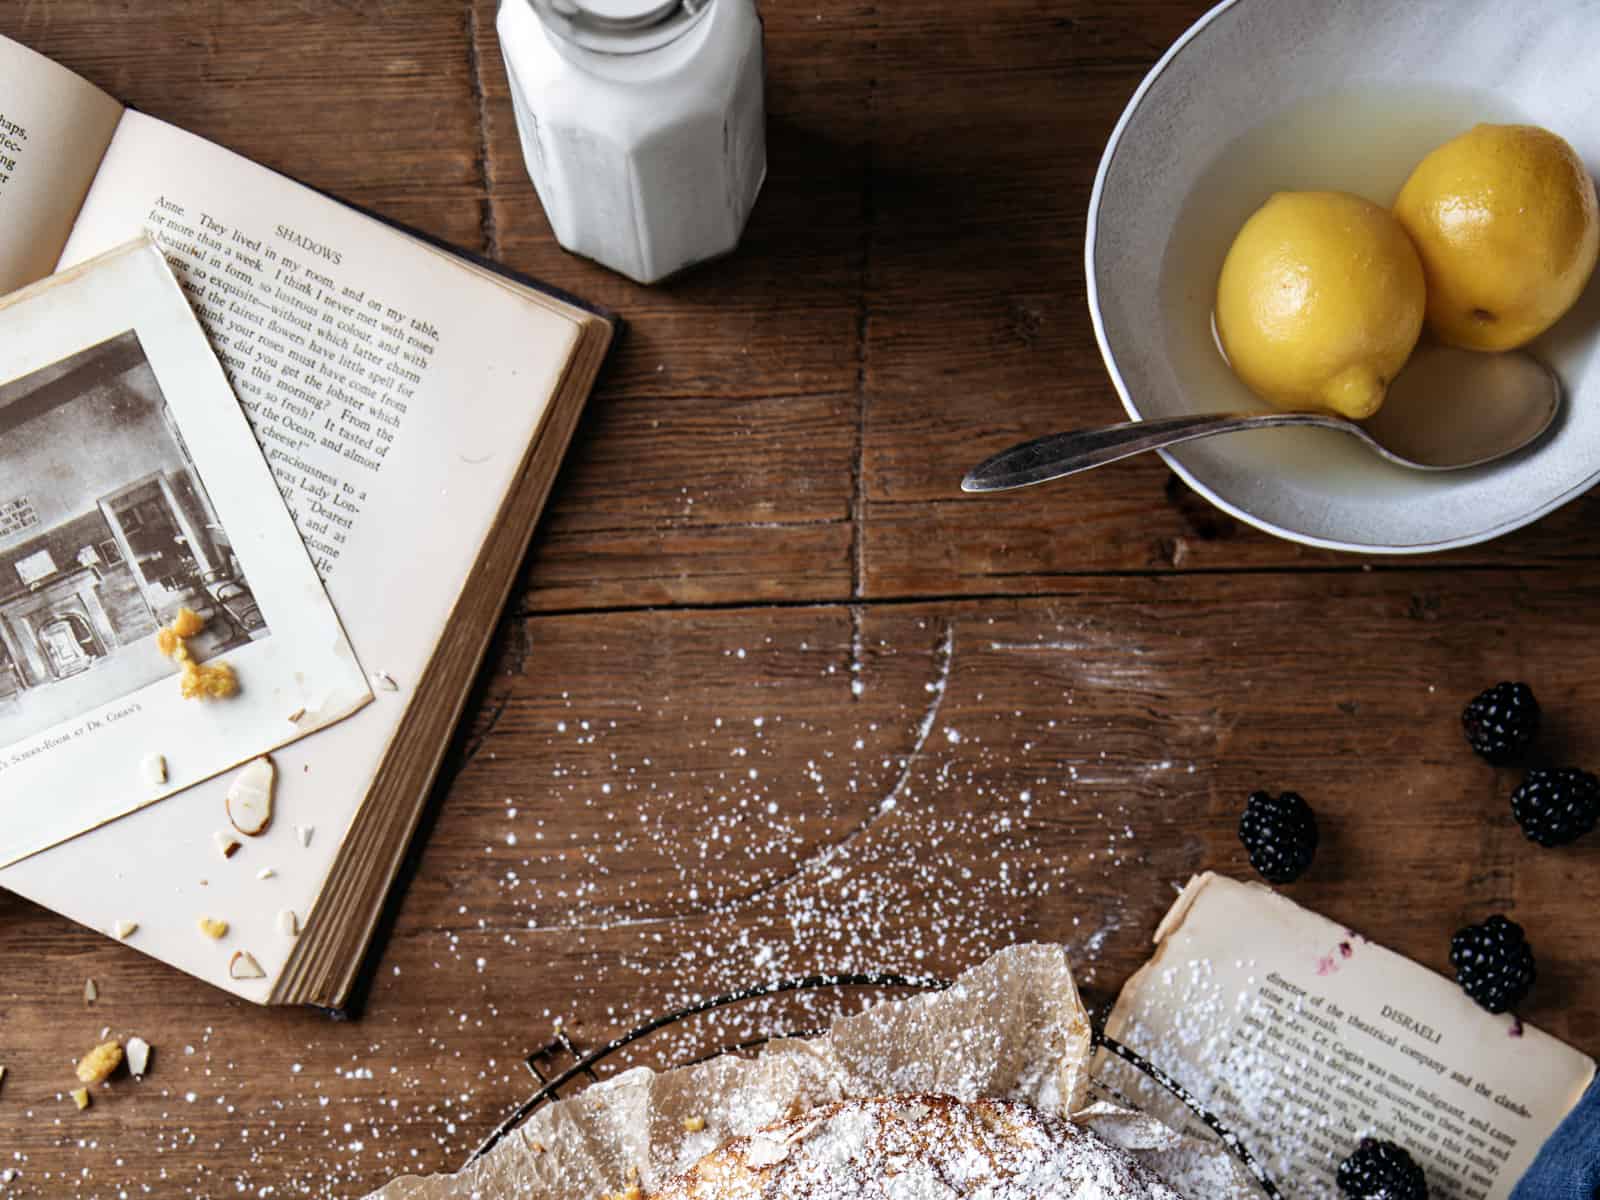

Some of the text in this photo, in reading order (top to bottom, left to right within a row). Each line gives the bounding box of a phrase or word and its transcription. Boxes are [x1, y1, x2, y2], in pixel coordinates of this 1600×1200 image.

[148, 209, 434, 355] for more than a week. I think I never met with roses
[155, 195, 185, 217] Anne.
[200, 213, 228, 237] They
[231, 229, 262, 252] lived
[264, 246, 277, 261] in
[280, 257, 300, 272] my
[341, 287, 365, 303] and
[367, 300, 382, 312] on
[386, 308, 406, 323] my
[275, 224, 342, 265] SHADOWS
[181, 277, 415, 398] and the fairest flowers have little spell for
[192, 268, 206, 279] so
[317, 327, 349, 350] which
[352, 343, 384, 366] latter
[386, 361, 421, 384] charm
[209, 257, 222, 269] in
[224, 262, 254, 287] form,
[260, 282, 272, 293] so
[274, 287, 318, 317] lustrous
[321, 313, 334, 325] in
[377, 340, 401, 356] and
[403, 351, 428, 369] with
[192, 299, 407, 414] think your roses must have come from
[233, 339, 254, 356] did
[254, 352, 278, 368] you
[280, 364, 300, 379] get
[304, 374, 322, 390] the
[326, 383, 364, 411] lobster
[369, 407, 400, 428] which
[241, 379, 261, 395] was
[265, 392, 278, 403] so
[280, 397, 315, 421] fresh!
[324, 418, 335, 432] It
[338, 427, 374, 450] tasted
[375, 445, 390, 458] of
[251, 366, 272, 383] this
[276, 379, 331, 411] morning?
[340, 408, 370, 432] From
[376, 427, 394, 443] the
[261, 407, 280, 422] the
[281, 415, 317, 443] Ocean,
[320, 437, 344, 454] and
[343, 448, 381, 472] almost
[267, 448, 367, 501] graciousness to a
[273, 467, 296, 484] was
[299, 477, 330, 501] Lady
[332, 493, 360, 513] Lon-
[305, 519, 346, 544] and as
[1258, 987, 1284, 1005] stine
[1380, 1005, 1442, 1044] DISRAELI
[1309, 996, 1325, 1008] of
[1326, 1004, 1344, 1019] the
[1347, 1015, 1398, 1048] theatrical
[1400, 1045, 1448, 1075] company
[1450, 1071, 1473, 1088] and
[1474, 1083, 1492, 1099] the
[1331, 1041, 1365, 1067] Cogan
[1367, 1062, 1386, 1077] was
[1387, 1073, 1415, 1093] most
[1468, 1117, 1491, 1133] and
[1489, 1128, 1517, 1147] came
[1364, 1079, 1371, 1088] a
[1373, 1083, 1421, 1114] discourse
[1421, 1110, 1435, 1122] on
[1438, 1117, 1464, 1137] these
[1466, 1133, 1486, 1148] new
[1488, 1145, 1511, 1162] and
[1357, 1108, 1372, 1123] he
[1433, 1150, 1461, 1171] have
[1461, 1164, 1470, 1176] I
[1471, 1172, 1493, 1188] seen
[1426, 1128, 1440, 1142] in
[1441, 1137, 1462, 1154] this
